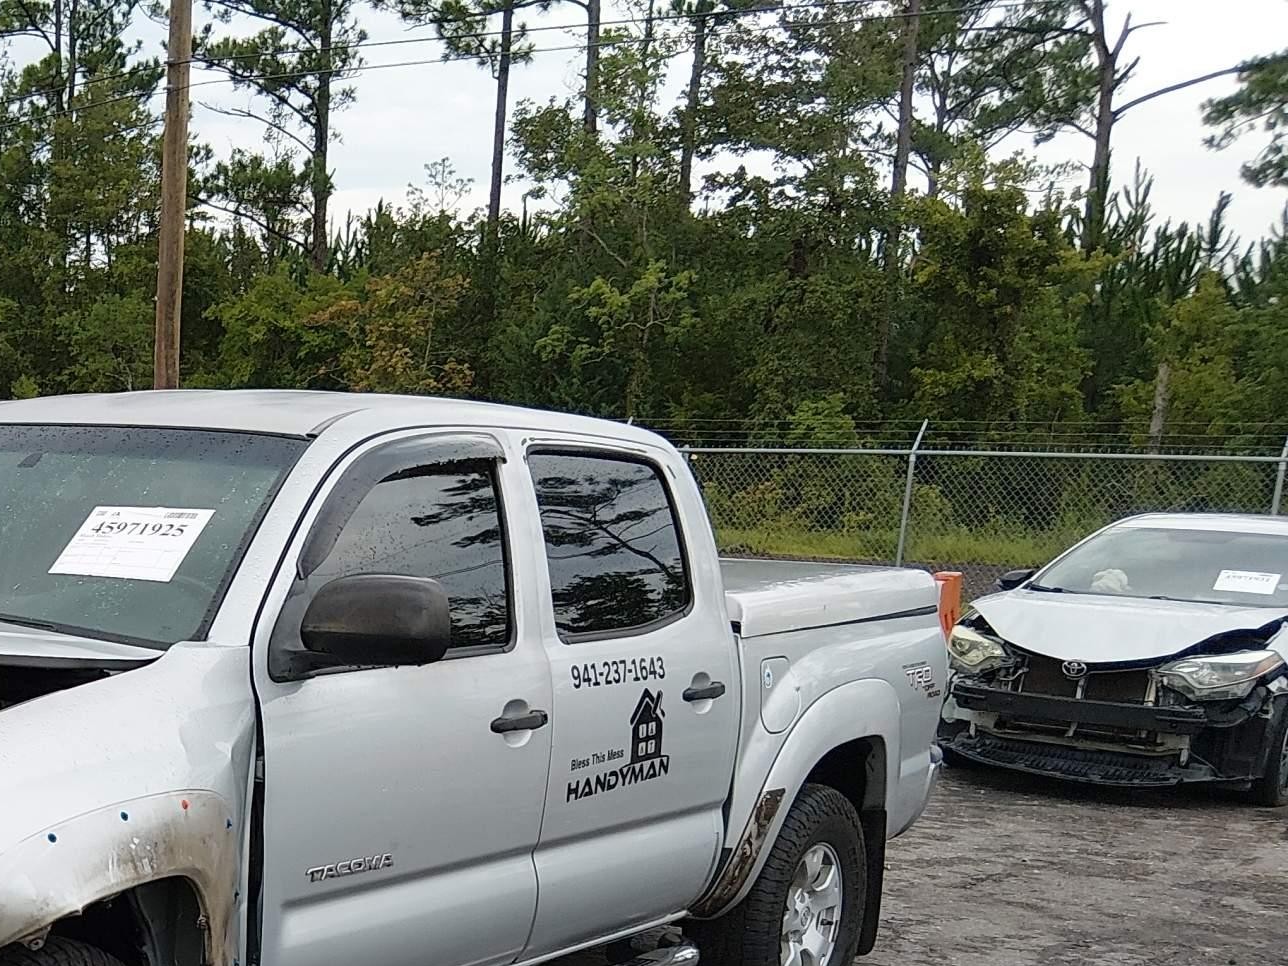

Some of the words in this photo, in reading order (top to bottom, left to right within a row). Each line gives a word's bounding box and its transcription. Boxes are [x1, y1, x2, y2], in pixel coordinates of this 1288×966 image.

[91, 521, 189, 537] 45971925
[571, 656, 665, 689] 941-237-1643
[905, 666, 932, 690] TRD
[570, 757, 590, 771] Bless
[591, 752, 606, 766] This
[566, 758, 669, 803] HANDYMAN
[305, 853, 393, 882] TACOMA
